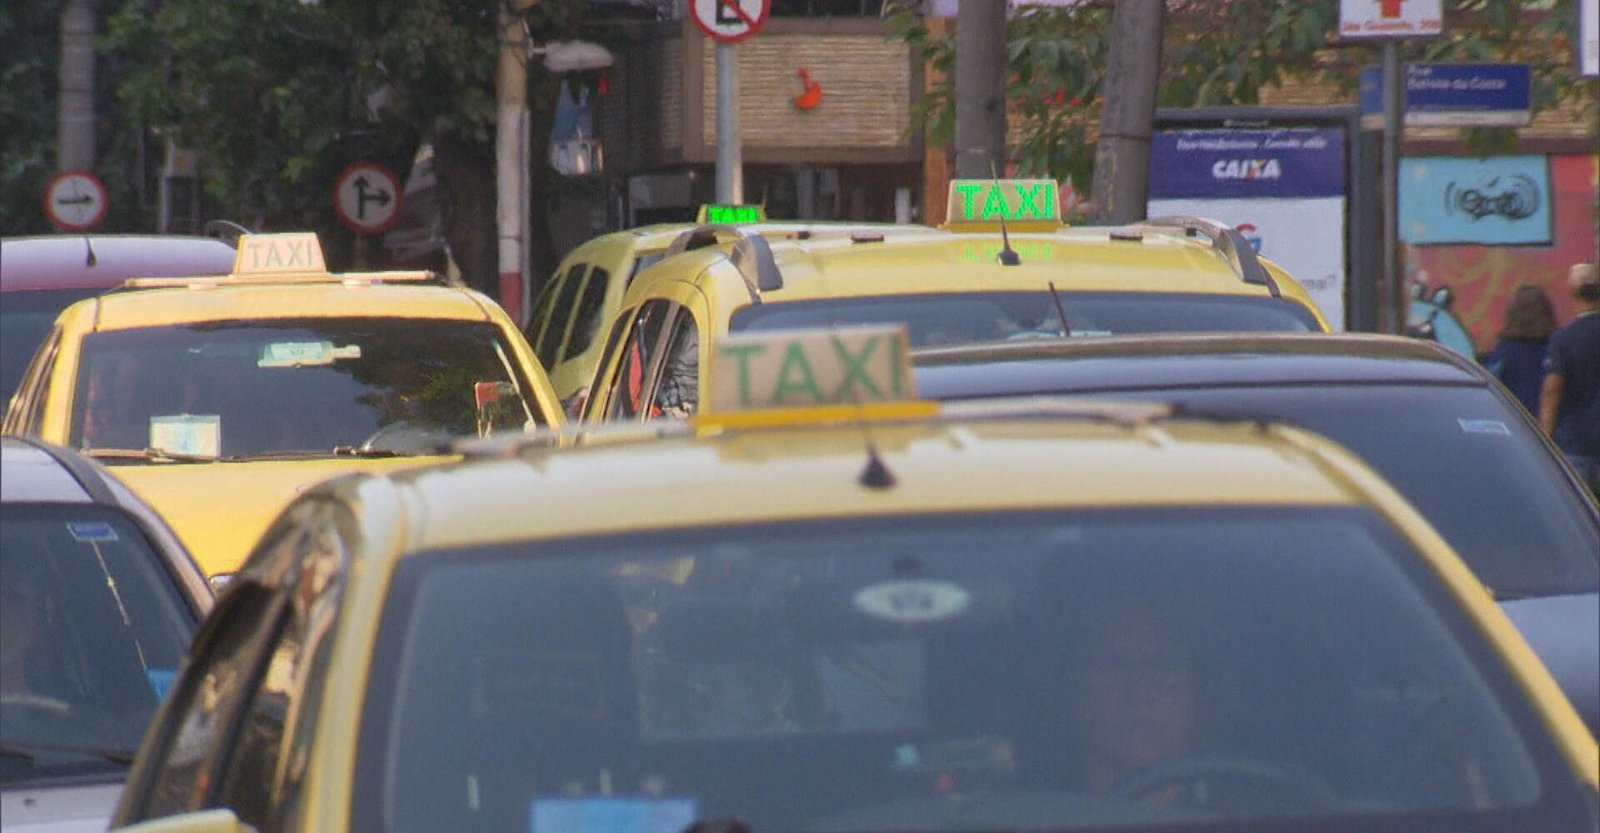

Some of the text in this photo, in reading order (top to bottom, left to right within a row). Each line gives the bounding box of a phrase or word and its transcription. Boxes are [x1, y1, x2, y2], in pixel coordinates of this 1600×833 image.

[1212, 158, 1282, 180] CAIXA
[708, 206, 757, 224] TAXI
[956, 183, 1053, 219] TAXI
[247, 240, 313, 269] TAXI
[721, 333, 904, 407] TAXI
